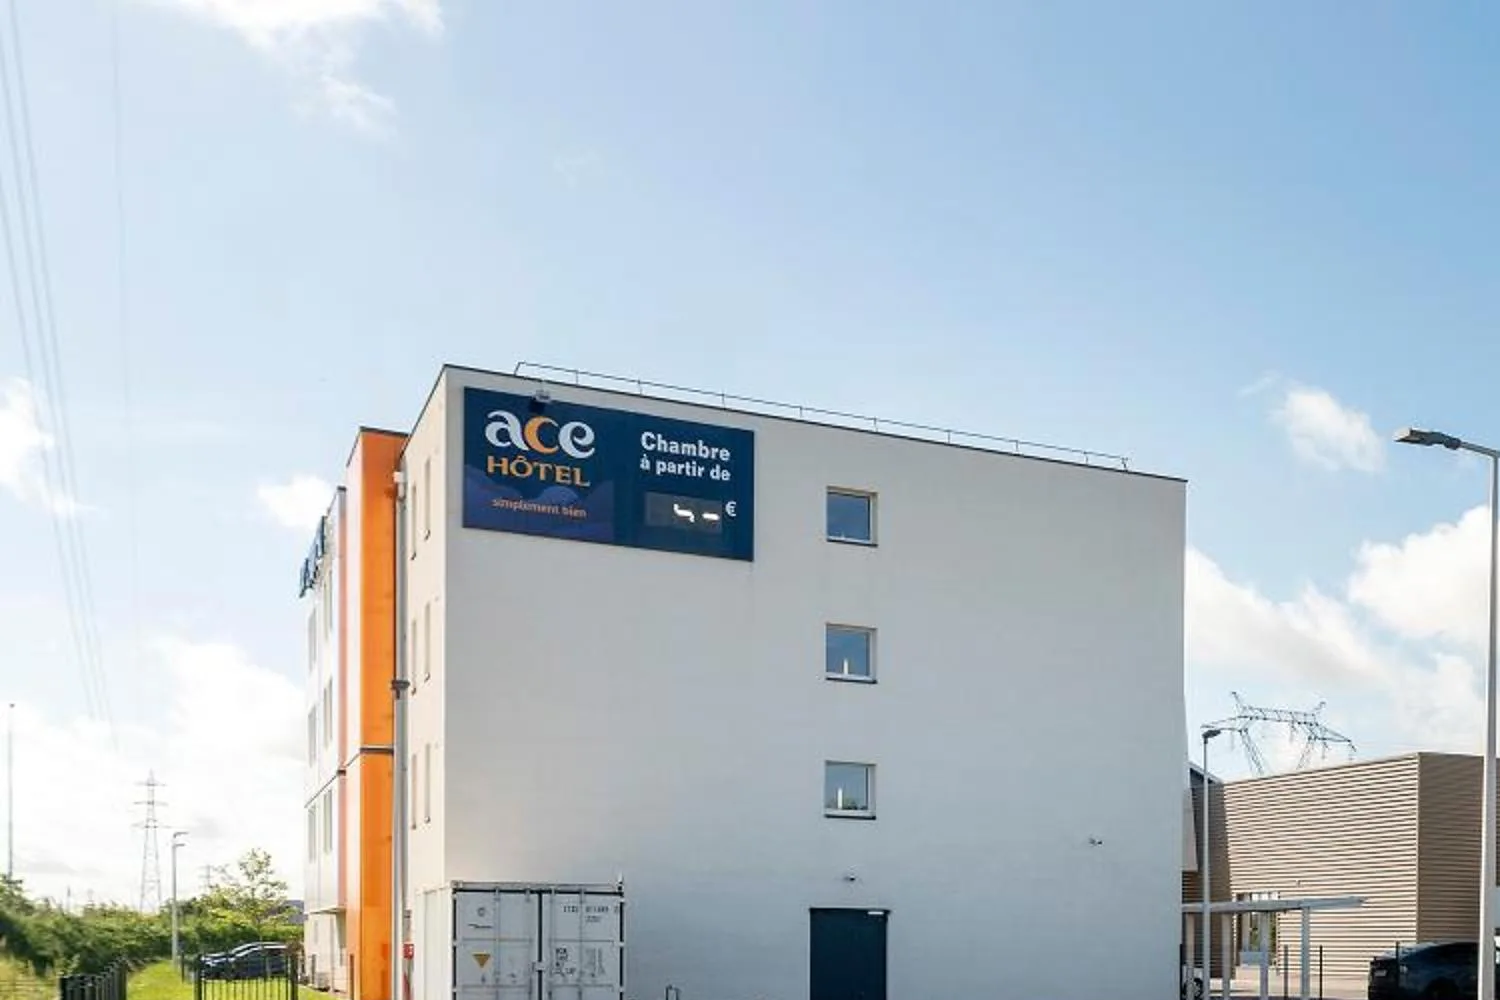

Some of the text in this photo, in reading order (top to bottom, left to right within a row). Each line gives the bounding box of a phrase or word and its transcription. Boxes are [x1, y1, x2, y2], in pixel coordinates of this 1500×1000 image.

[485, 409, 596, 459] ace
[641, 431, 730, 461] Chambre
[487, 455, 591, 487] HÔTEL
[640, 453, 731, 481] à partir de
[725, 501, 737, 517] €
